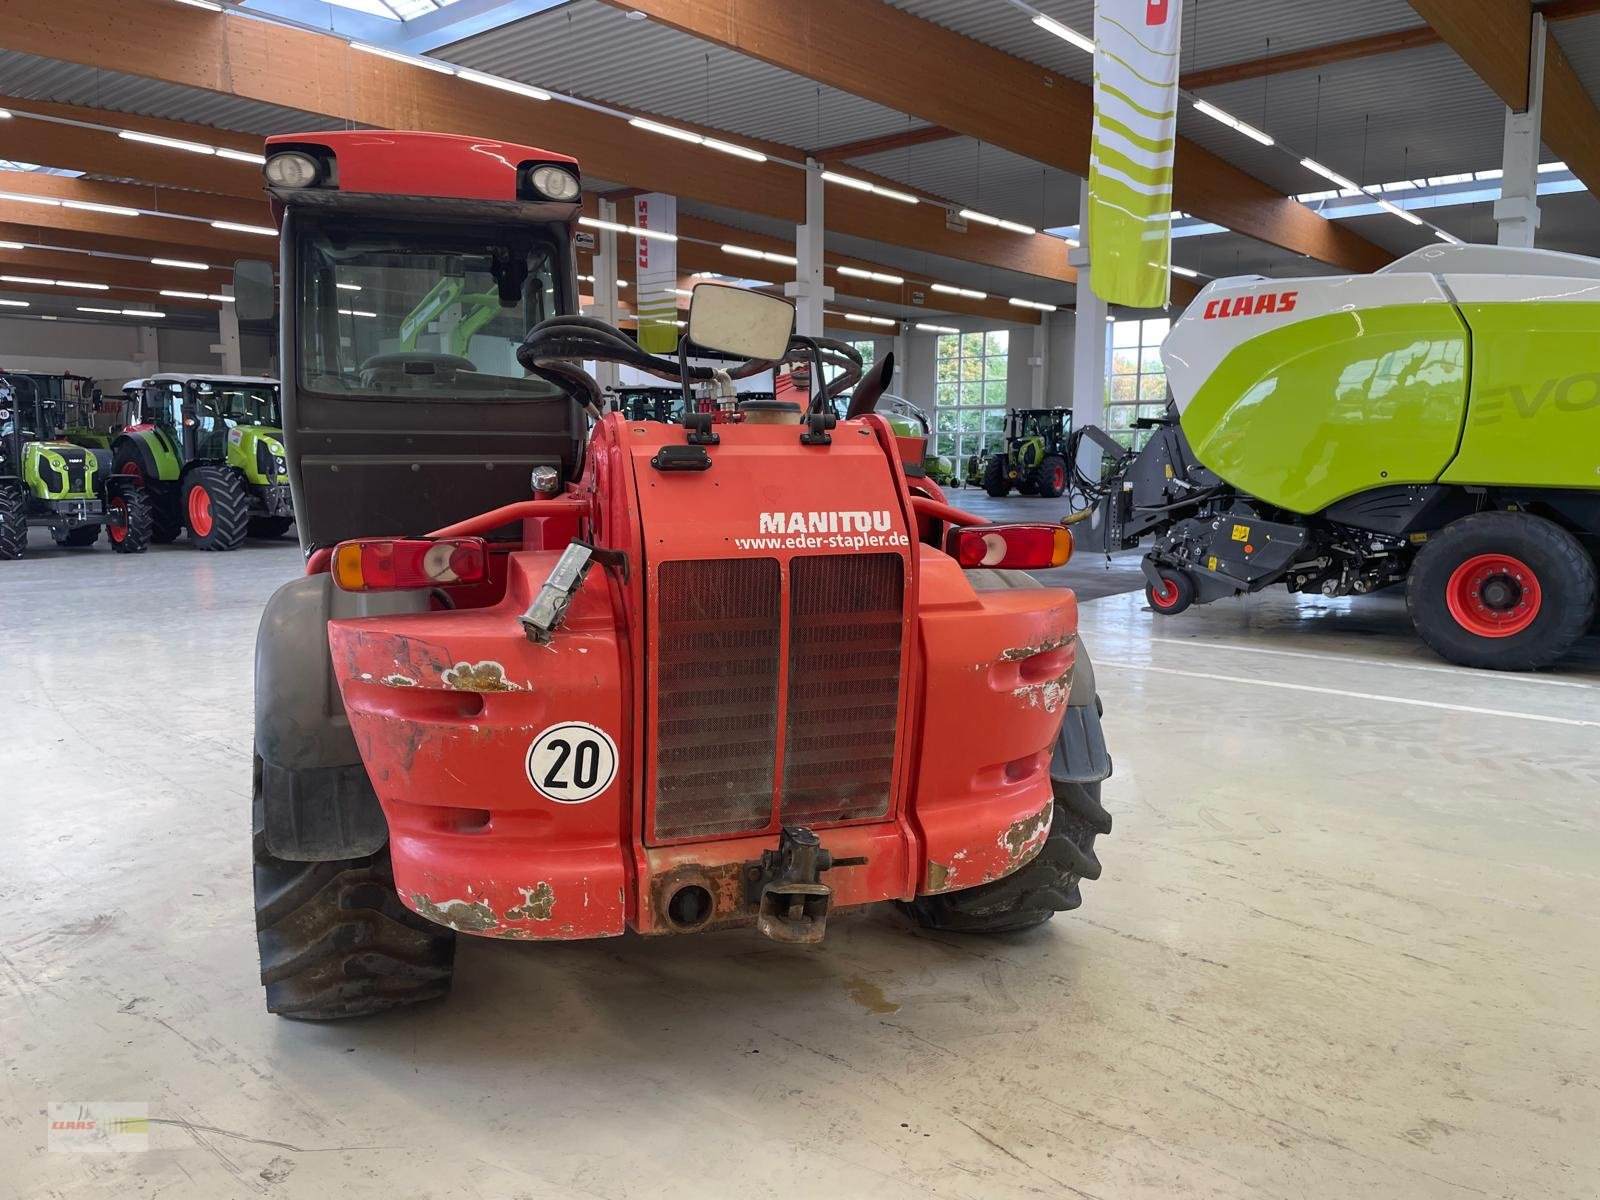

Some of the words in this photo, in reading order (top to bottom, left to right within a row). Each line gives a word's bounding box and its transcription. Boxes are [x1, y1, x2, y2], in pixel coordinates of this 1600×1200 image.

[1203, 291, 1298, 320] CLAAS
[759, 510, 891, 534] MANITOU
[735, 531, 909, 550] www.eder-stapler.de
[543, 739, 600, 789] 20
